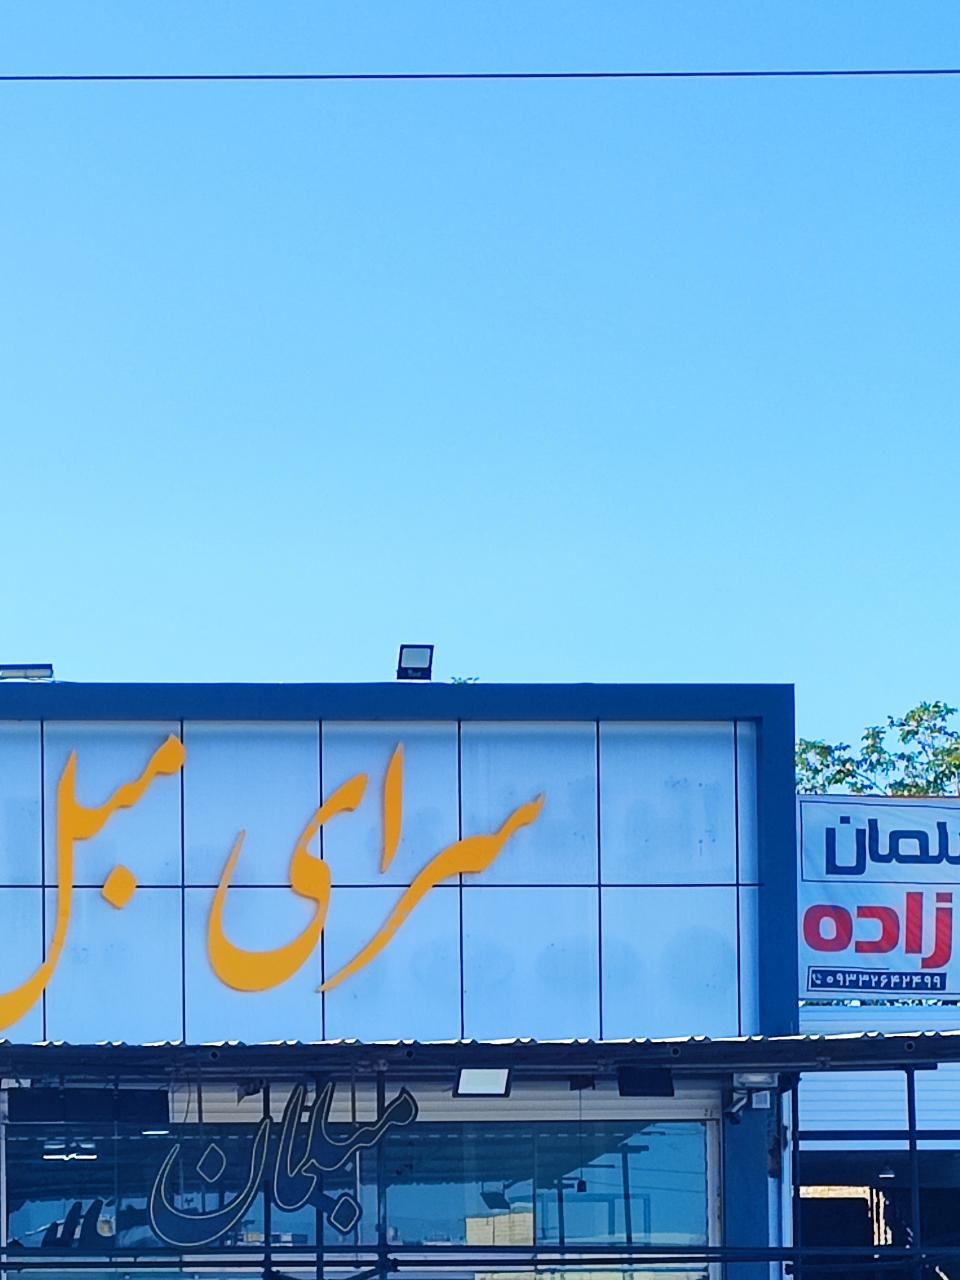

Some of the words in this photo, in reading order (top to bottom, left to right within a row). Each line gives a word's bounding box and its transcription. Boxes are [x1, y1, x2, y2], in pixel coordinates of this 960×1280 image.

[207, 742, 544, 993] سرای
[825, 816, 960, 876] لمان
[803, 891, 953, 969] زاده
[149, 1081, 419, 1247] مبلمان
